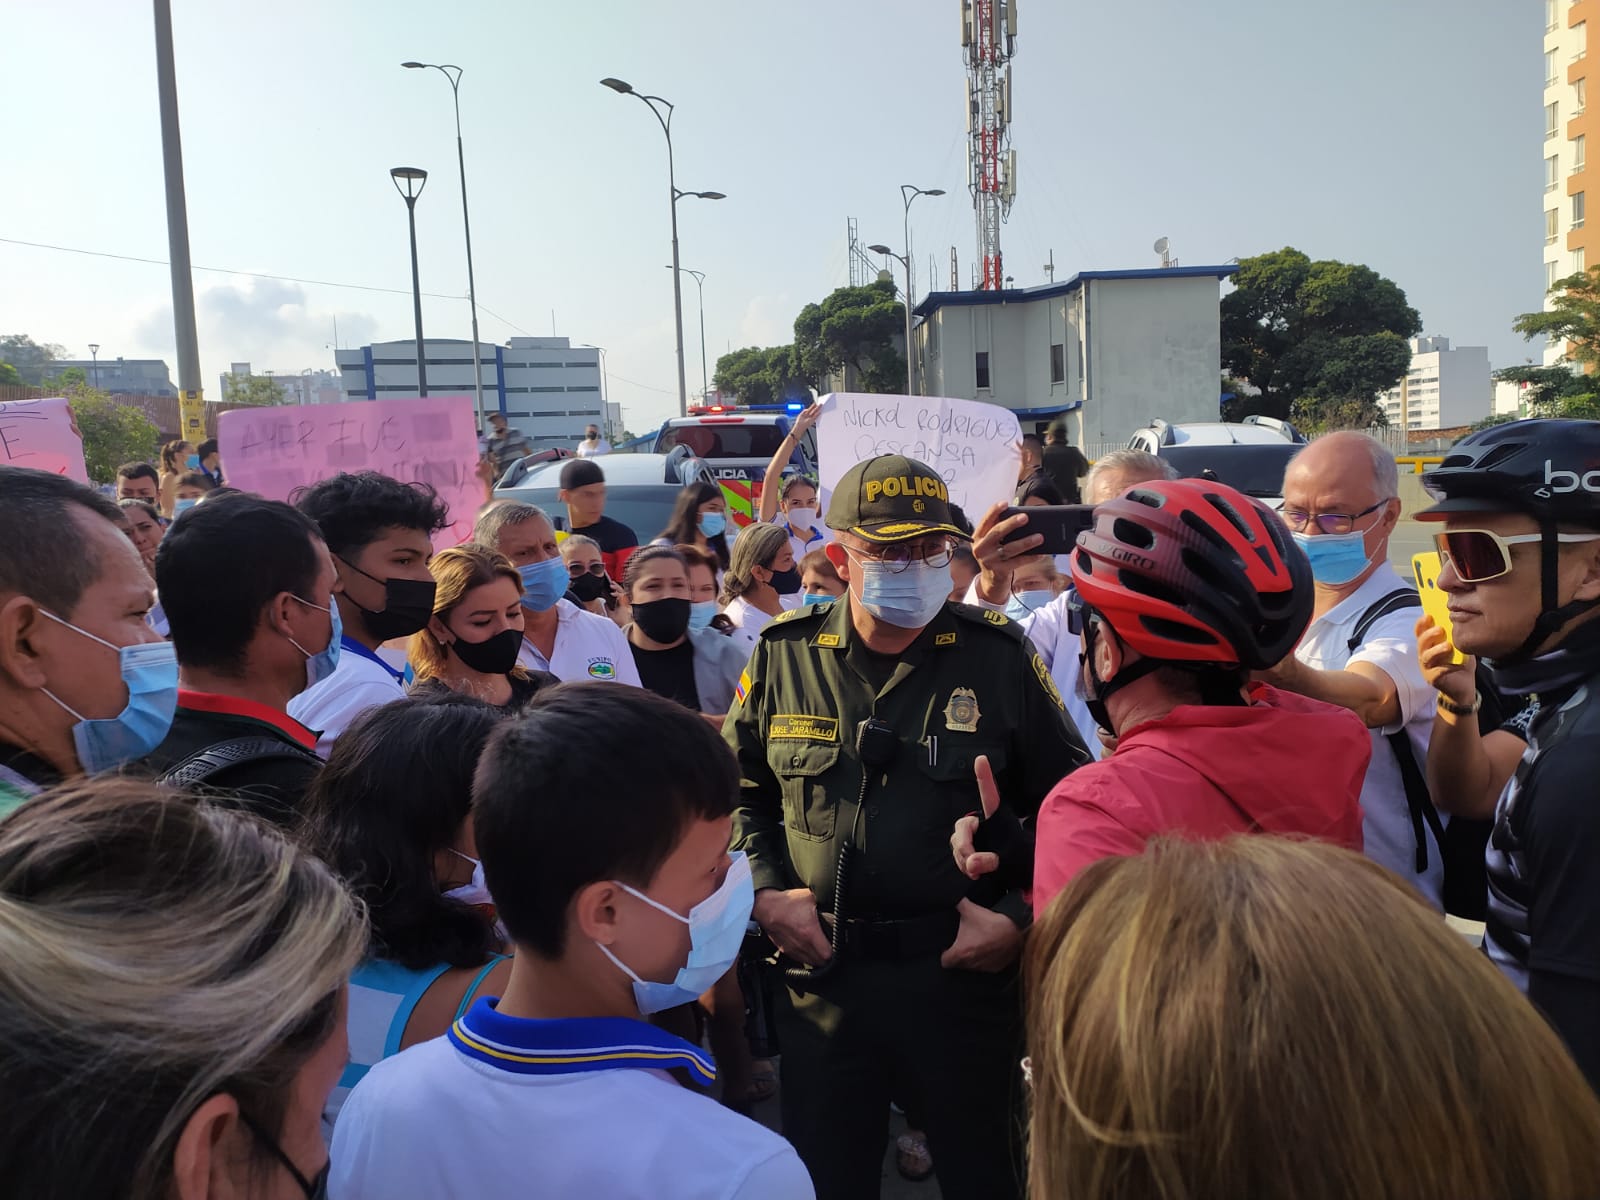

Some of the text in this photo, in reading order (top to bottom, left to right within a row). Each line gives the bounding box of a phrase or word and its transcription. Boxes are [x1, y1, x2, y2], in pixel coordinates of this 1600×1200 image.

[865, 476, 948, 504] POLICIA
[1112, 547, 1156, 570] GIRO
[789, 726, 833, 738] JARAMILLO
